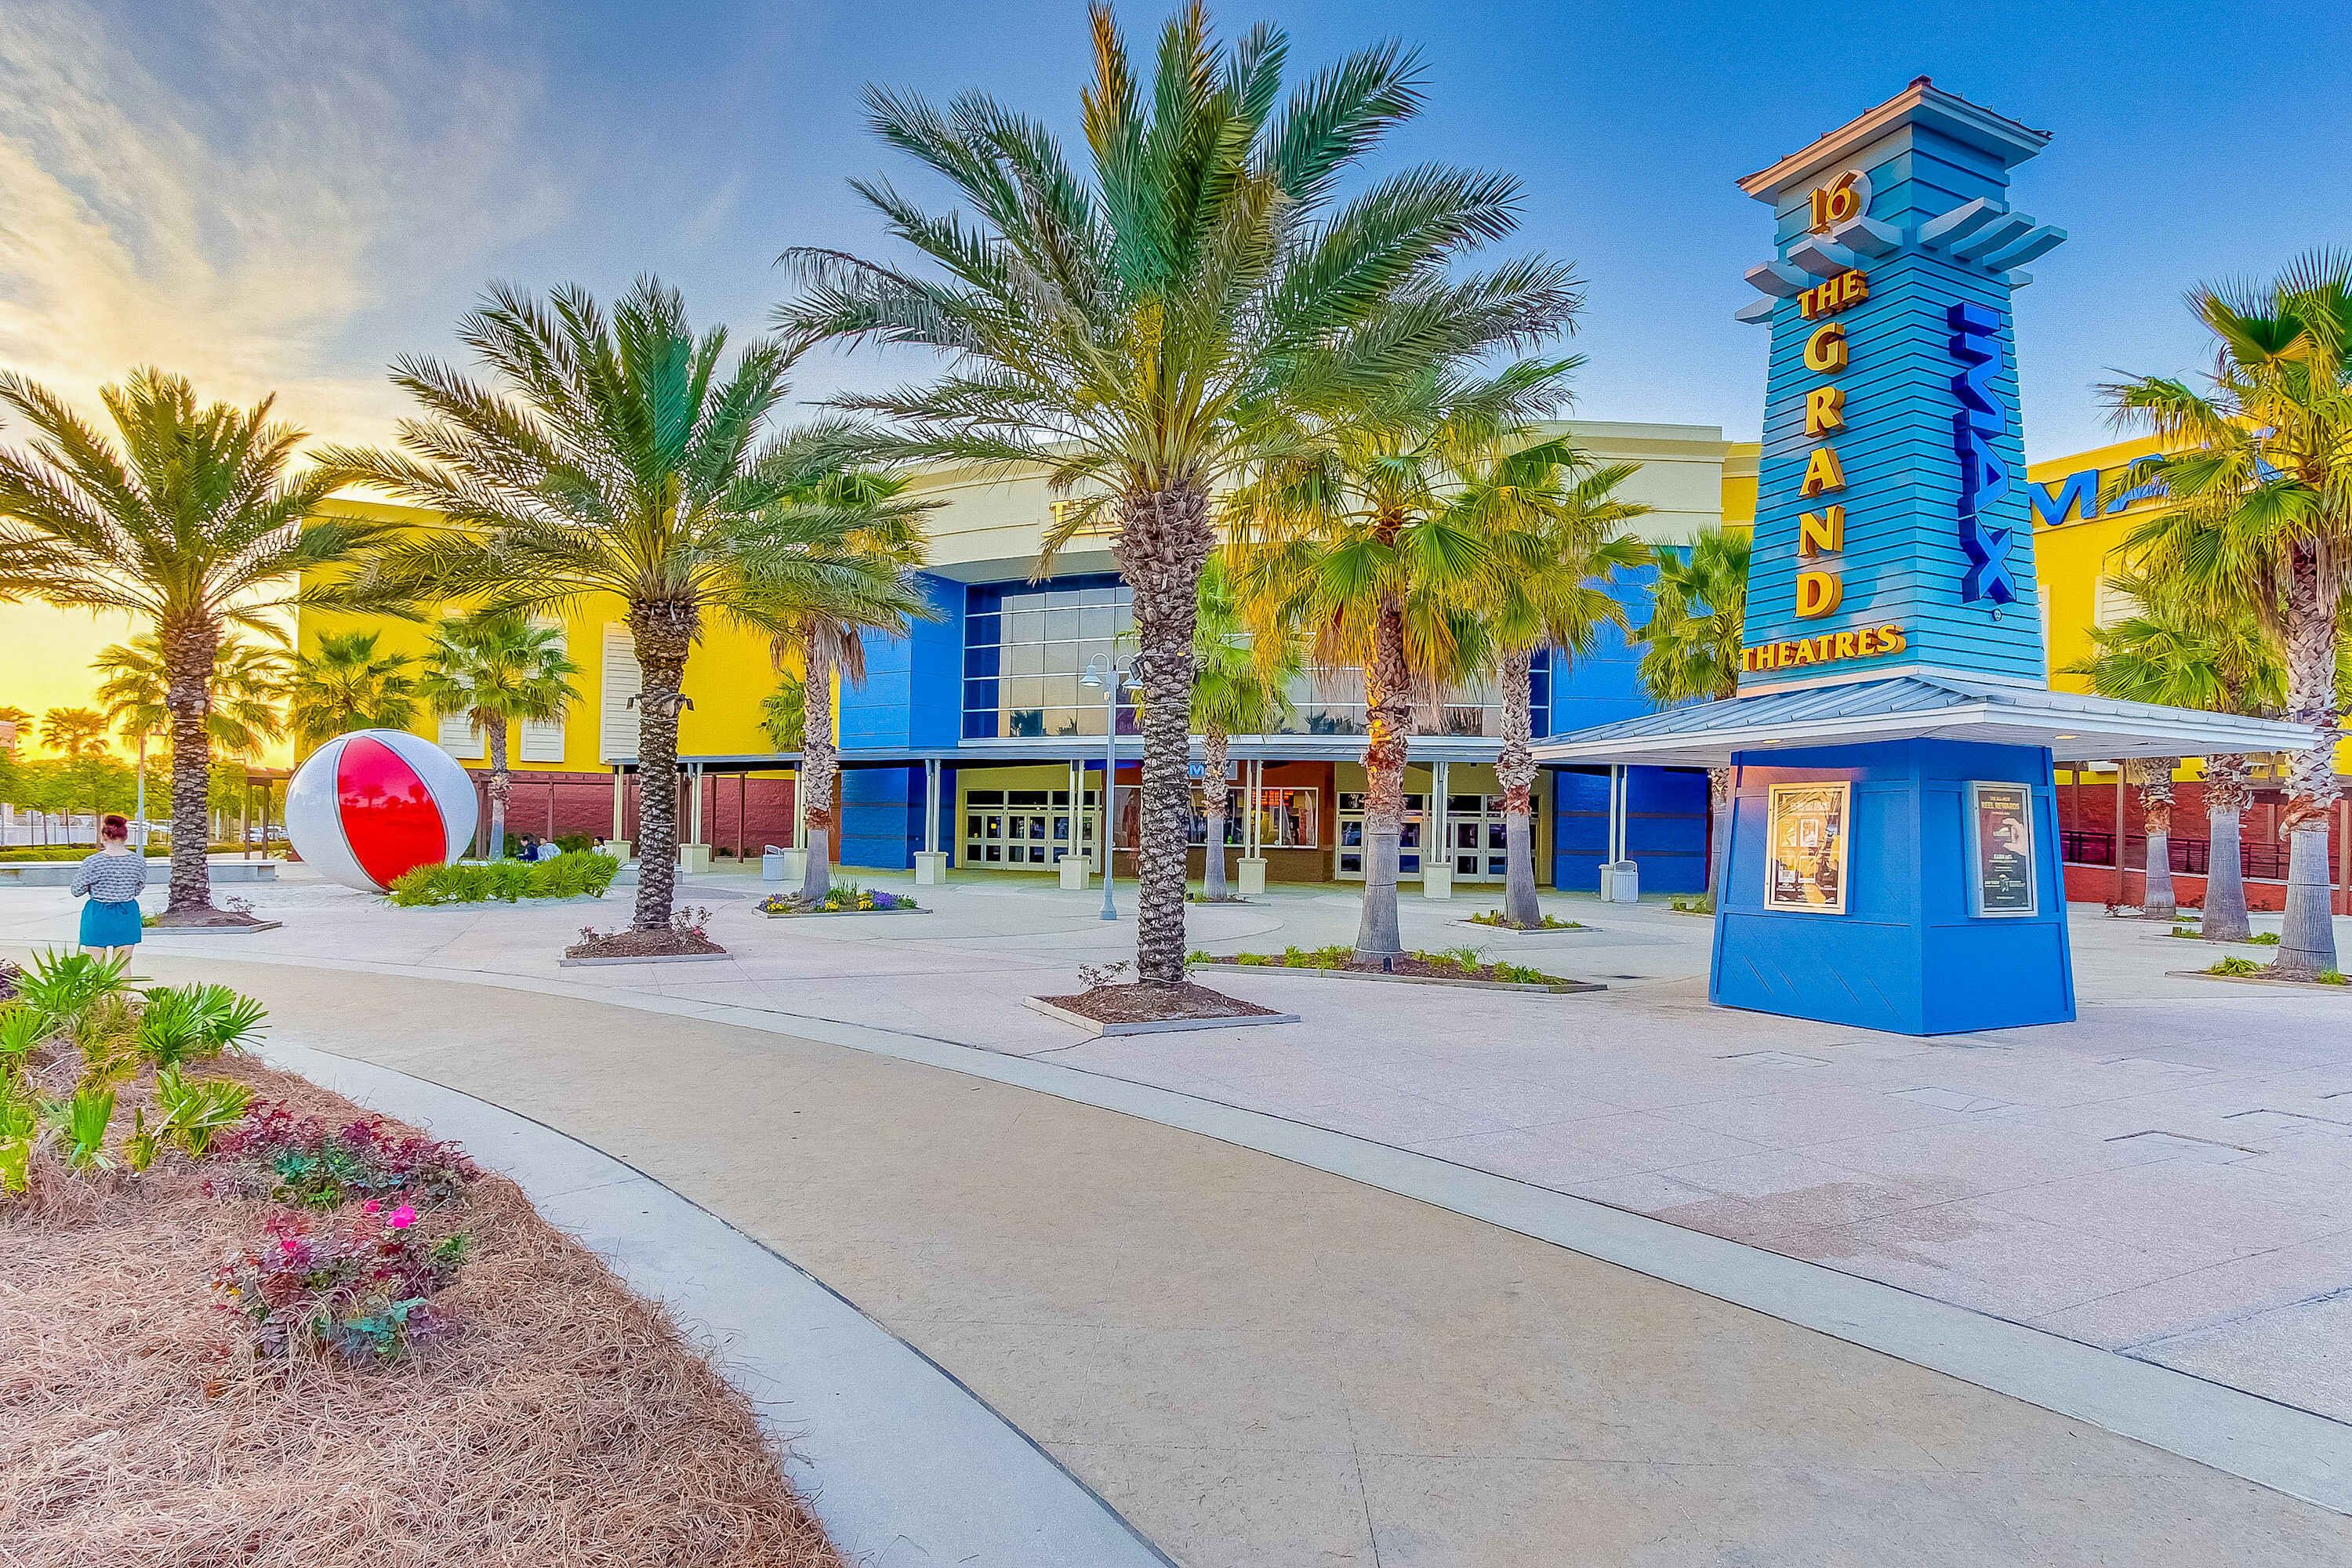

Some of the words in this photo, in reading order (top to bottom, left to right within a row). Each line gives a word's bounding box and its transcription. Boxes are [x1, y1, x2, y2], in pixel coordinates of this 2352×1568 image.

[1806, 170, 1860, 234] 16
[1797, 269, 1869, 321] THE
[1793, 322, 1848, 618] GRAND
[1947, 301, 2017, 604] IMAX
[1739, 624, 1907, 672] THEATRES
